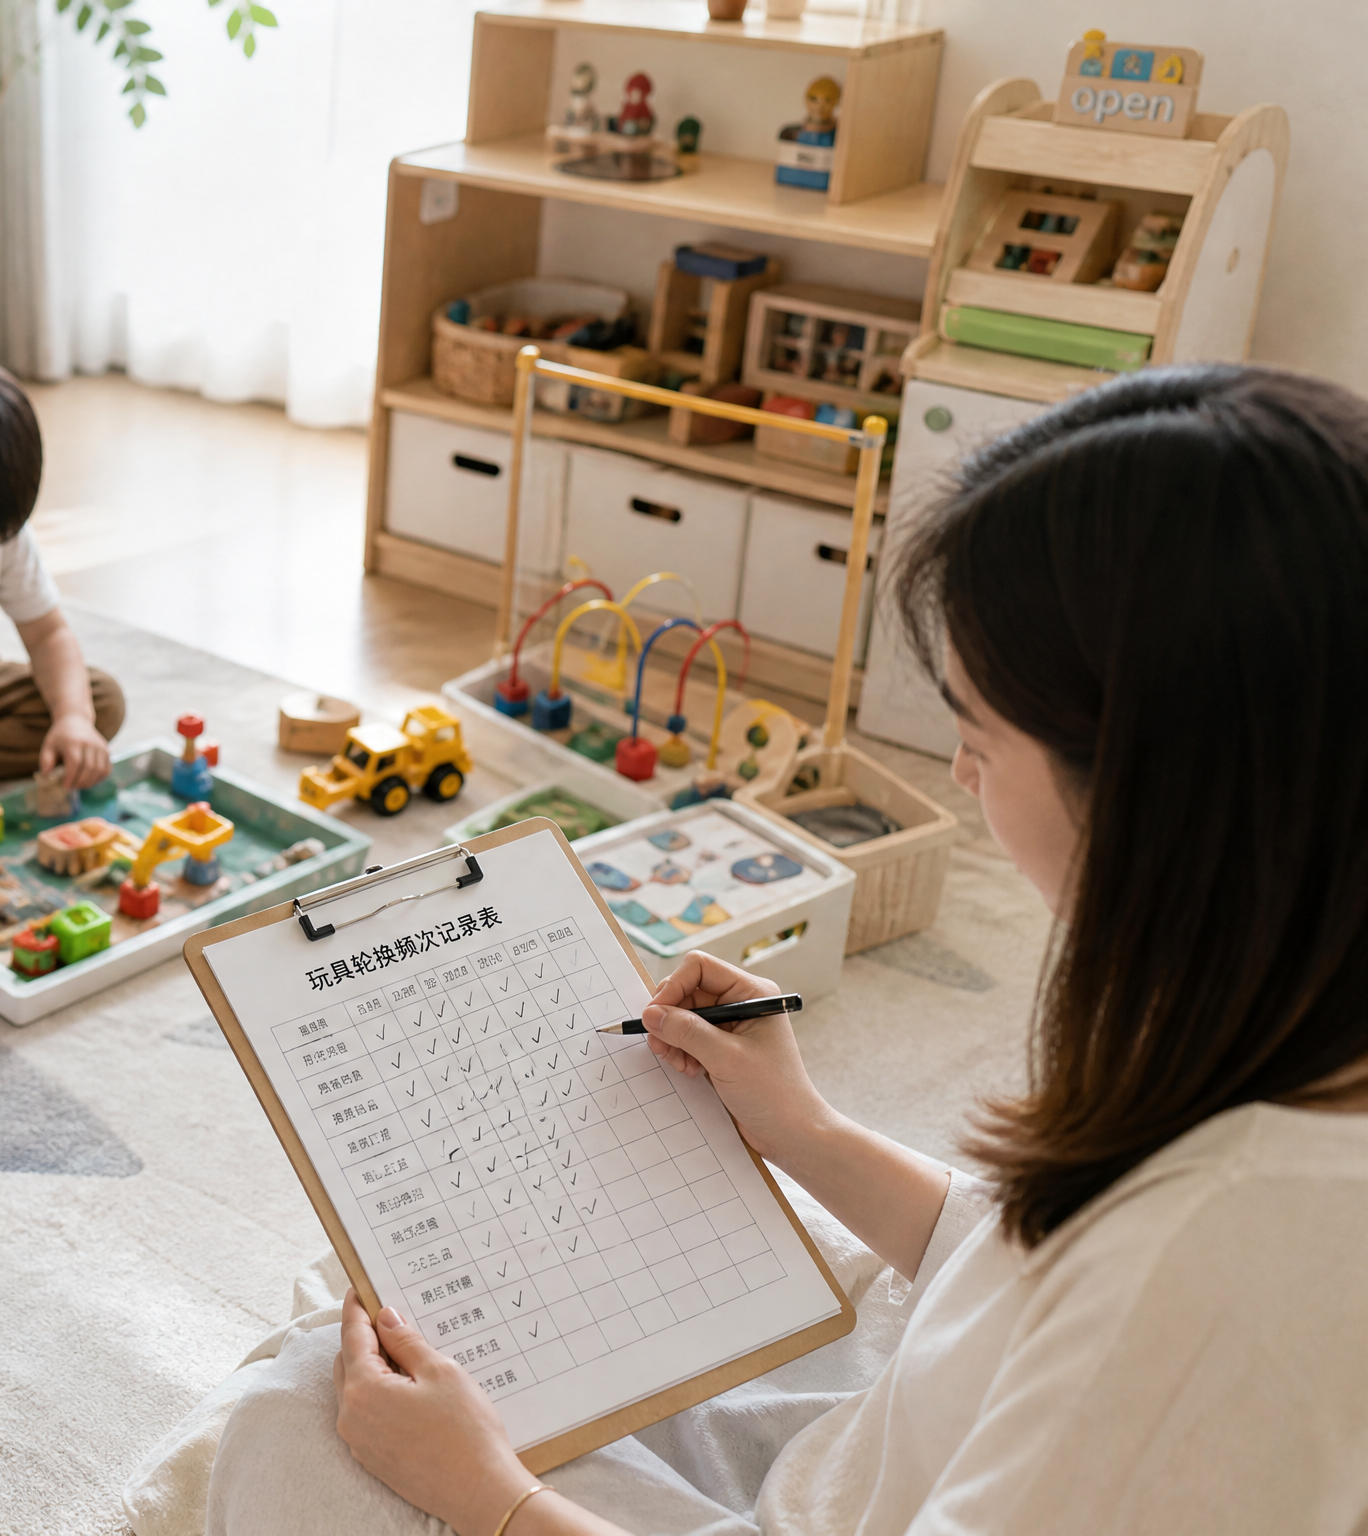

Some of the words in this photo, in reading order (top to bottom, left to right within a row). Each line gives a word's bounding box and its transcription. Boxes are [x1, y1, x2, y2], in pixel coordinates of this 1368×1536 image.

[1070, 86, 1175, 124] open
[304, 905, 503, 992] 玩具轮换频次记录表
